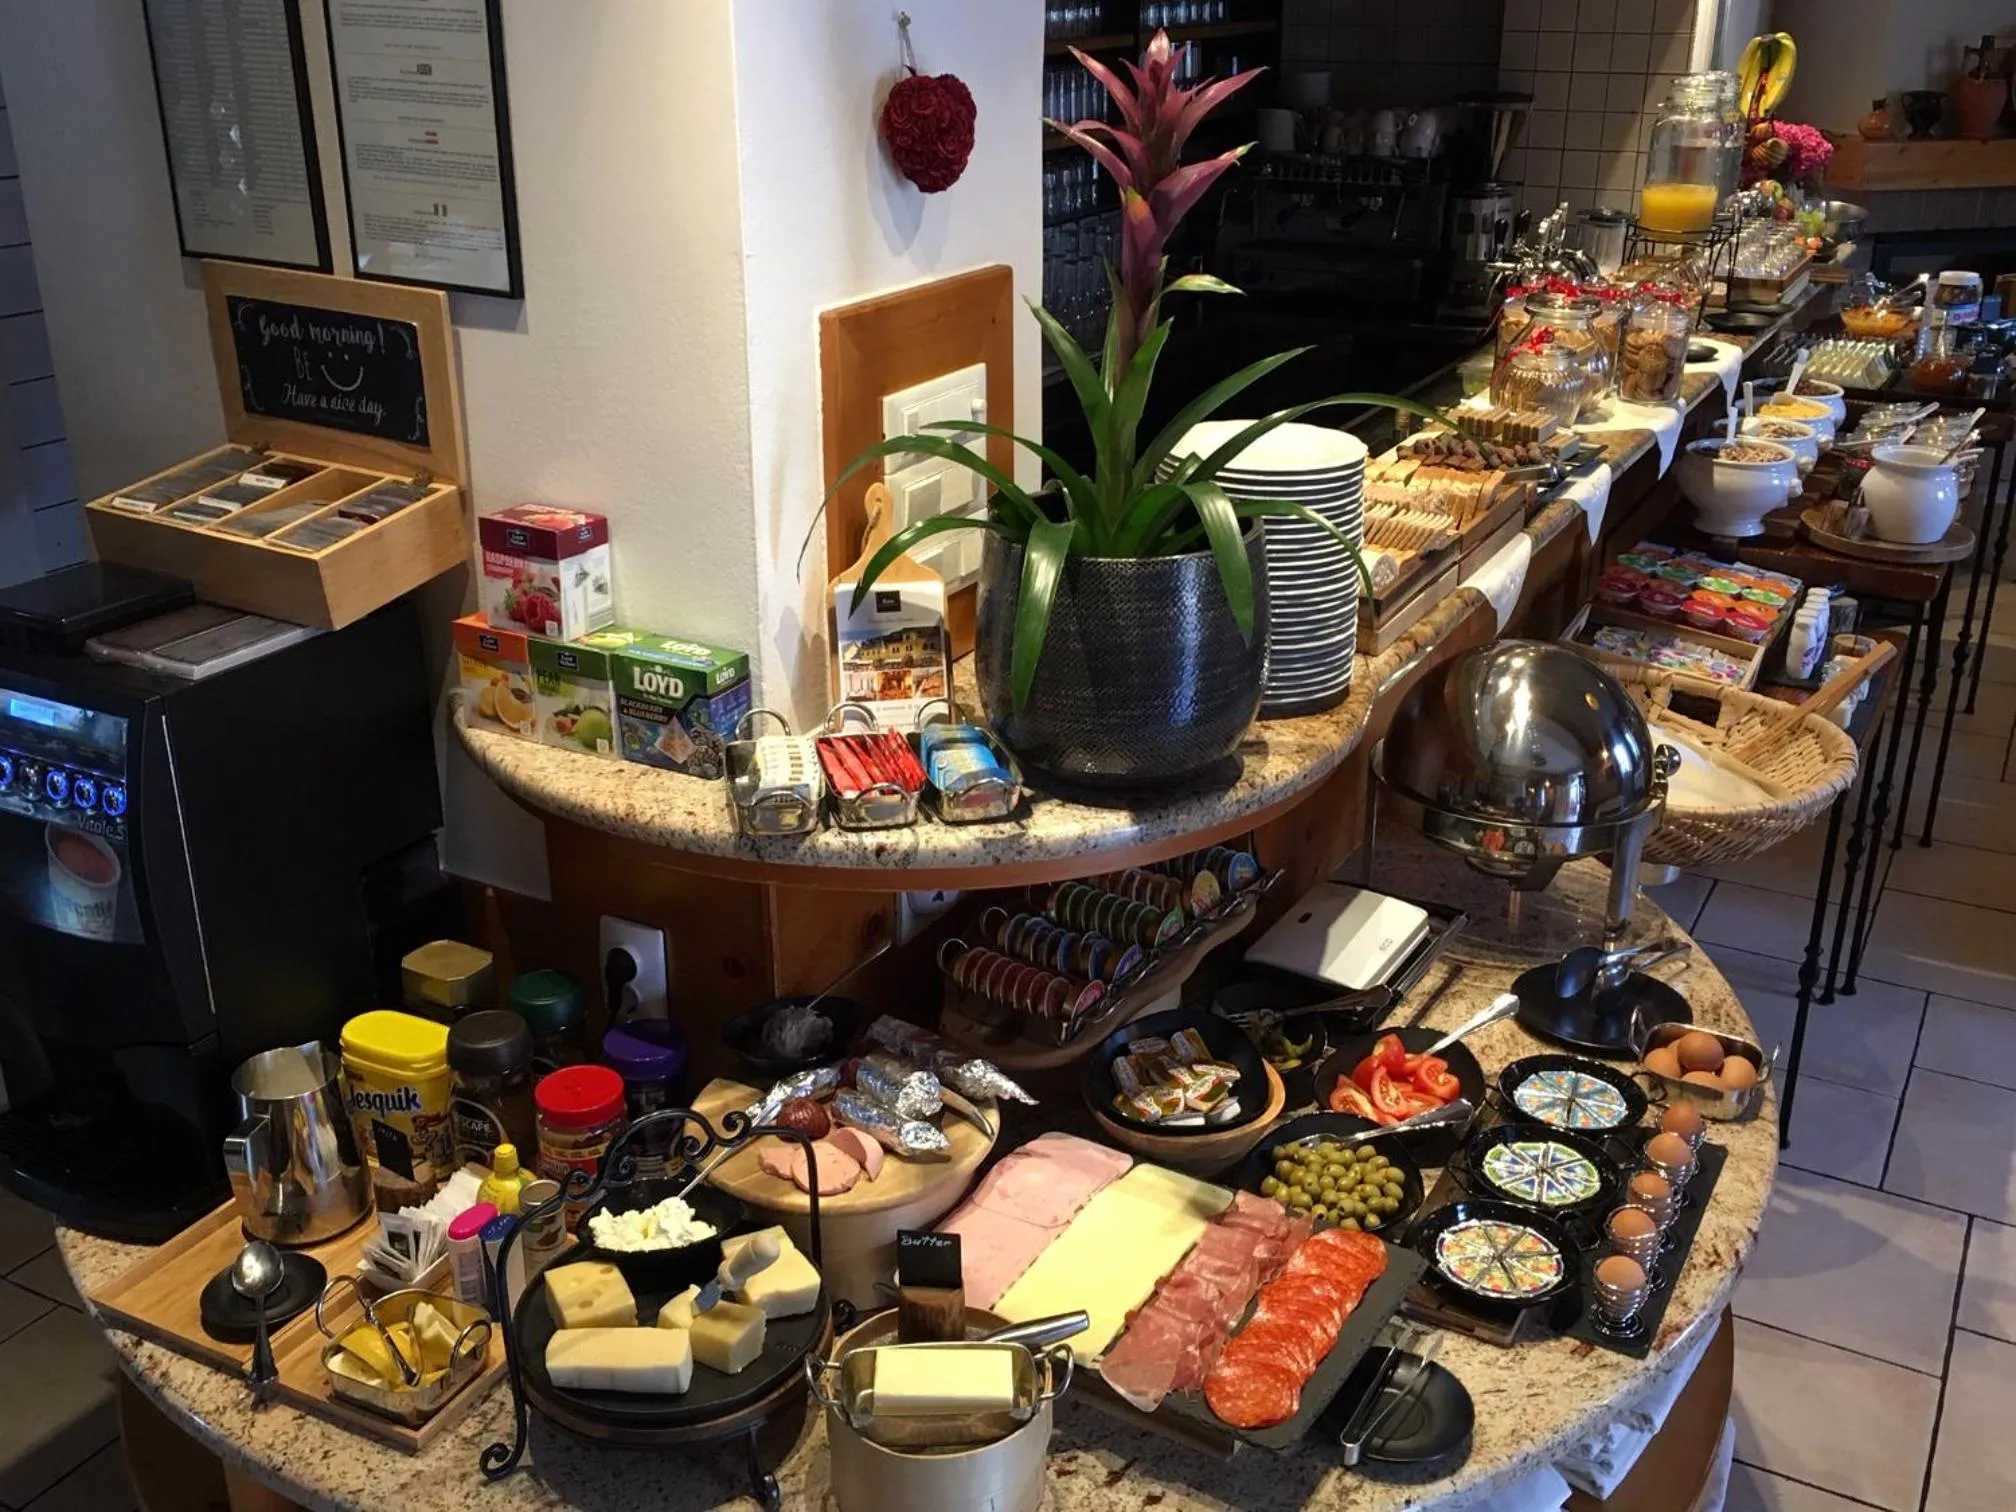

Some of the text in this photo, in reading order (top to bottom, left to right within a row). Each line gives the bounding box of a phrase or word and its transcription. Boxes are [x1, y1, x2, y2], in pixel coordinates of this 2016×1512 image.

[259, 314, 385, 352] Good morning!
[293, 347, 312, 380] BE
[282, 383, 317, 405] Have
[319, 395, 328, 409] a
[329, 394, 355, 412] nice
[632, 665, 684, 698] LOYD
[715, 666, 736, 685] LOYD
[901, 1234, 952, 1248] Butter
